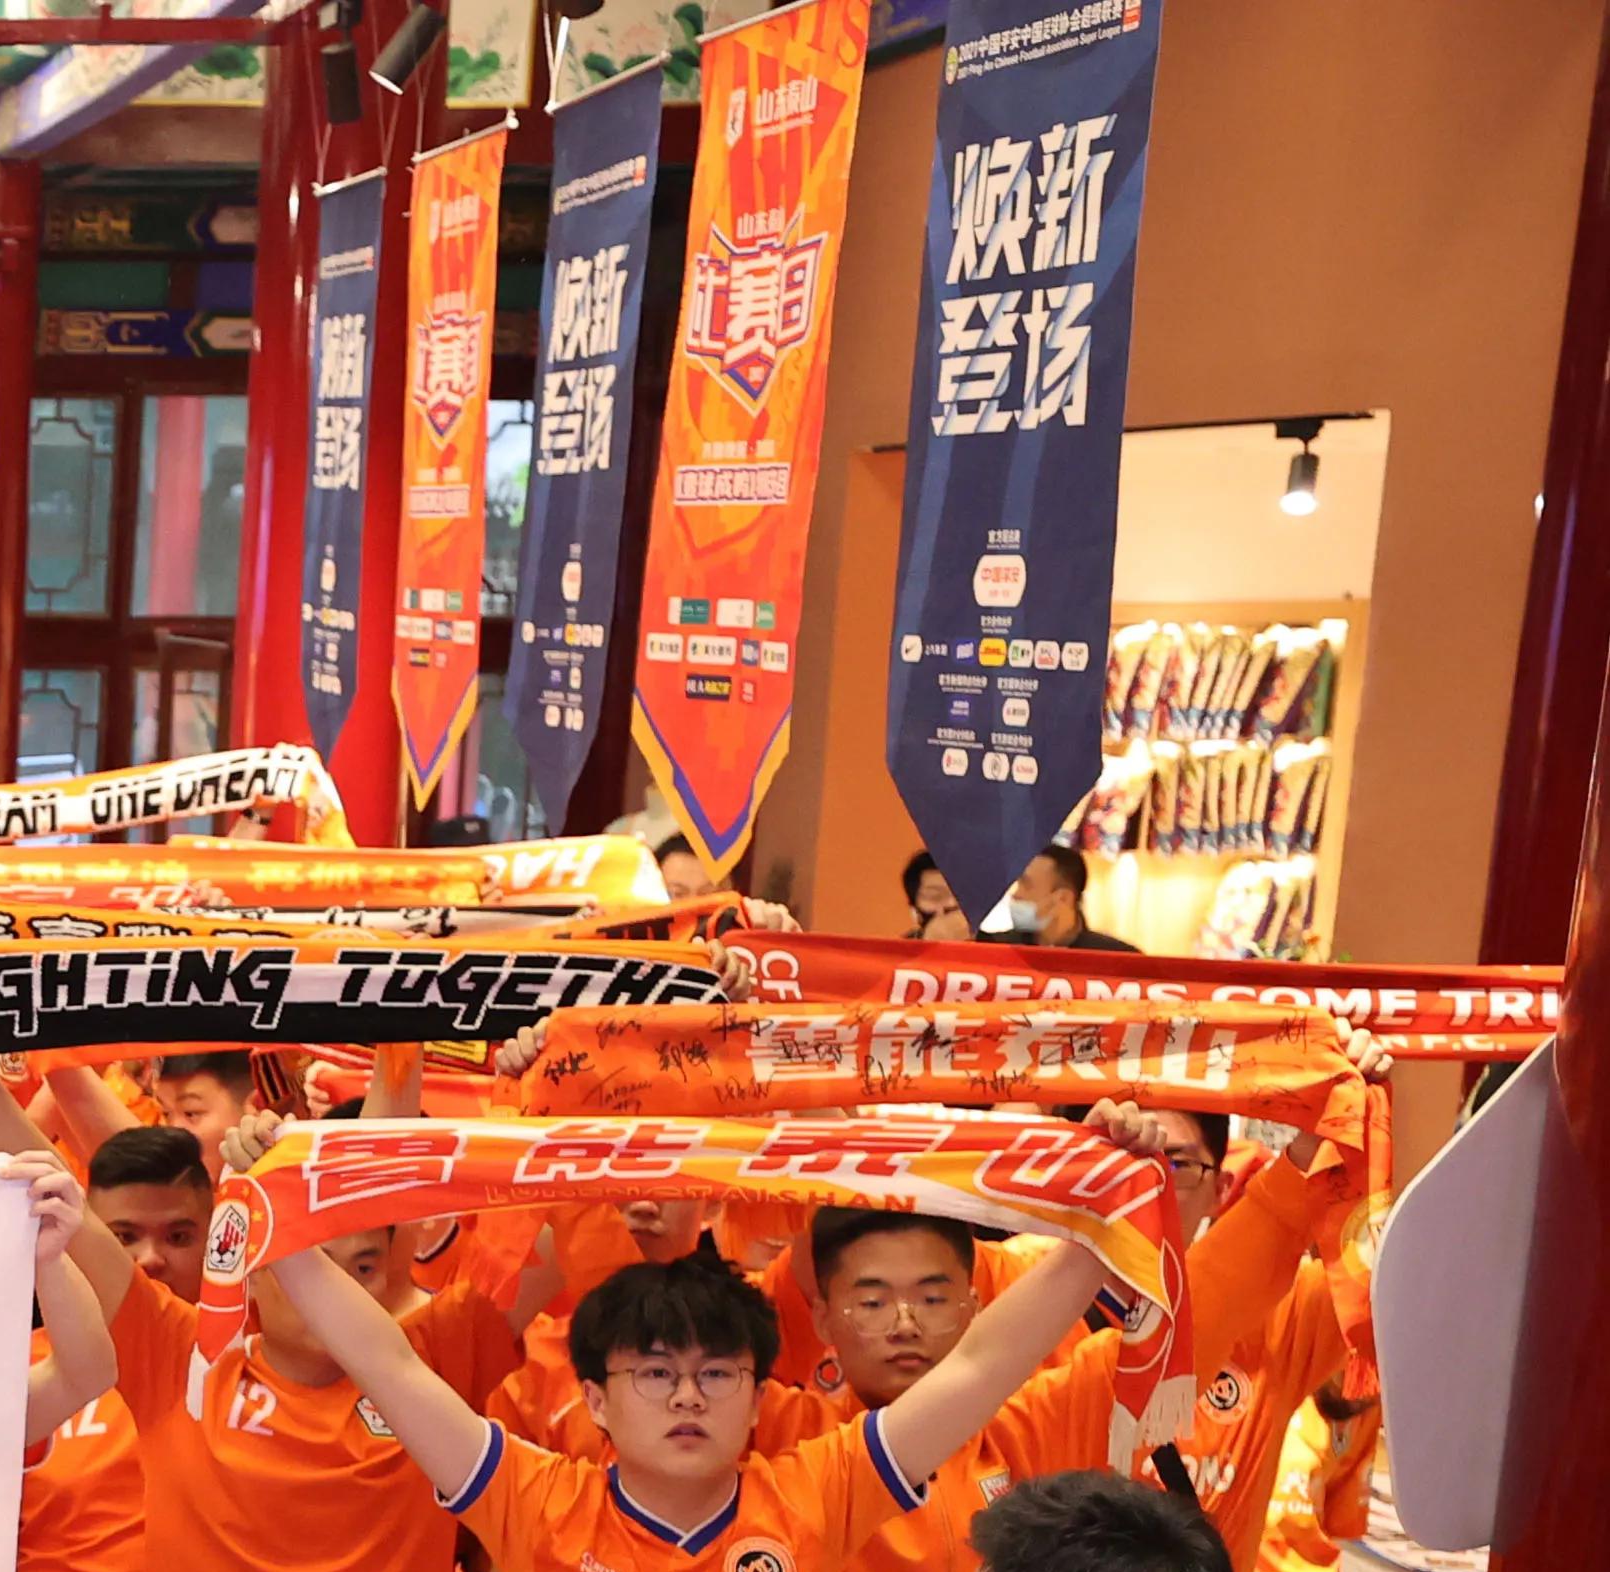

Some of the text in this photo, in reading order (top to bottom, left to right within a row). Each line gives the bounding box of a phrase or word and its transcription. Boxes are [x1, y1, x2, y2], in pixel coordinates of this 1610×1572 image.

[946, 113, 1118, 285] 焕新
[546, 243, 630, 364] 焕新
[931, 282, 1095, 436] 登场
[537, 363, 618, 477] 登场
[889, 967, 1188, 1002] DREAMS
[745, 1009, 1238, 1094] 鲁能泰山
[227, 1381, 278, 1438] 12
